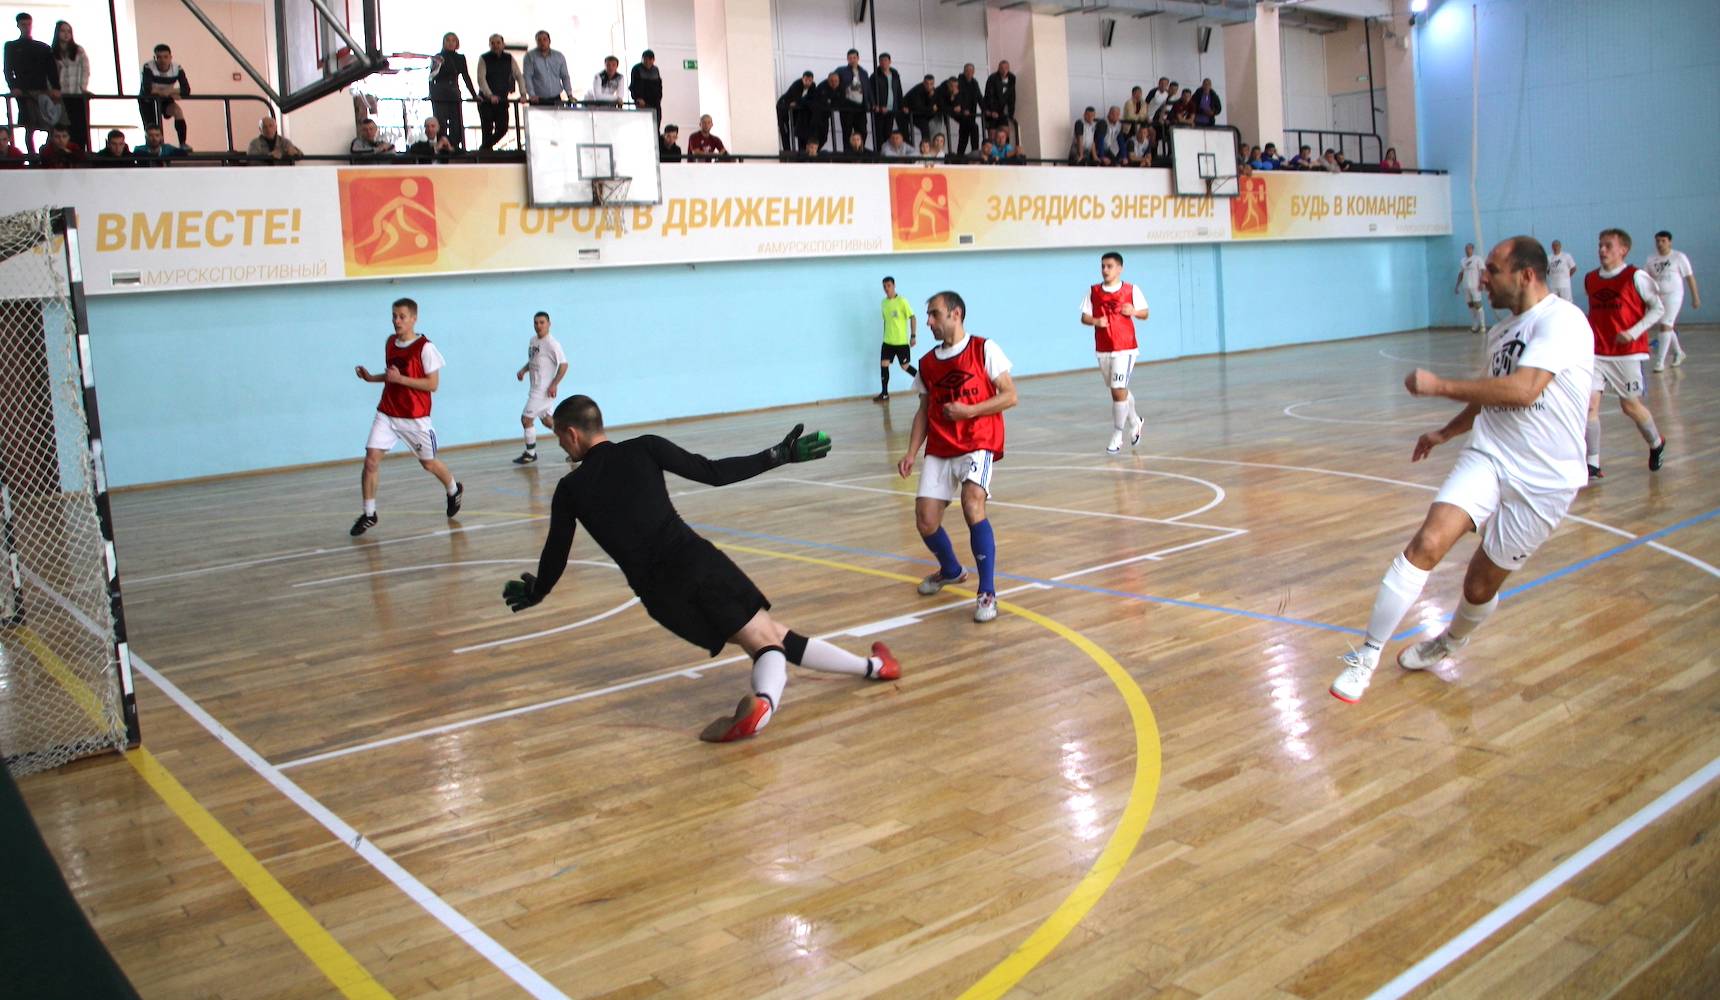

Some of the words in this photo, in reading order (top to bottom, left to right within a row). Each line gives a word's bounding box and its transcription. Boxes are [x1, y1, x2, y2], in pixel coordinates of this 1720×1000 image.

[498, 202, 622, 240] ГОРОД
[632, 203, 654, 231] В
[661, 196, 855, 237] ДВИЖЕНИИ!
[986, 194, 1105, 225] ЗАРЯДИСЬ
[1290, 194, 1330, 221] БУДЬ
[1333, 195, 1343, 216] В
[1346, 194, 1417, 219] КОМАНДЕ!
[96, 208, 301, 252] ВМЕСТЕ!
[758, 237, 882, 254] #АМУРСКСПОРТИВНЫЙ
[142, 259, 328, 286] МУРСКСПОРТИВНЫЙ
[1625, 381, 1639, 392] 13
[969, 461, 977, 473] 5
